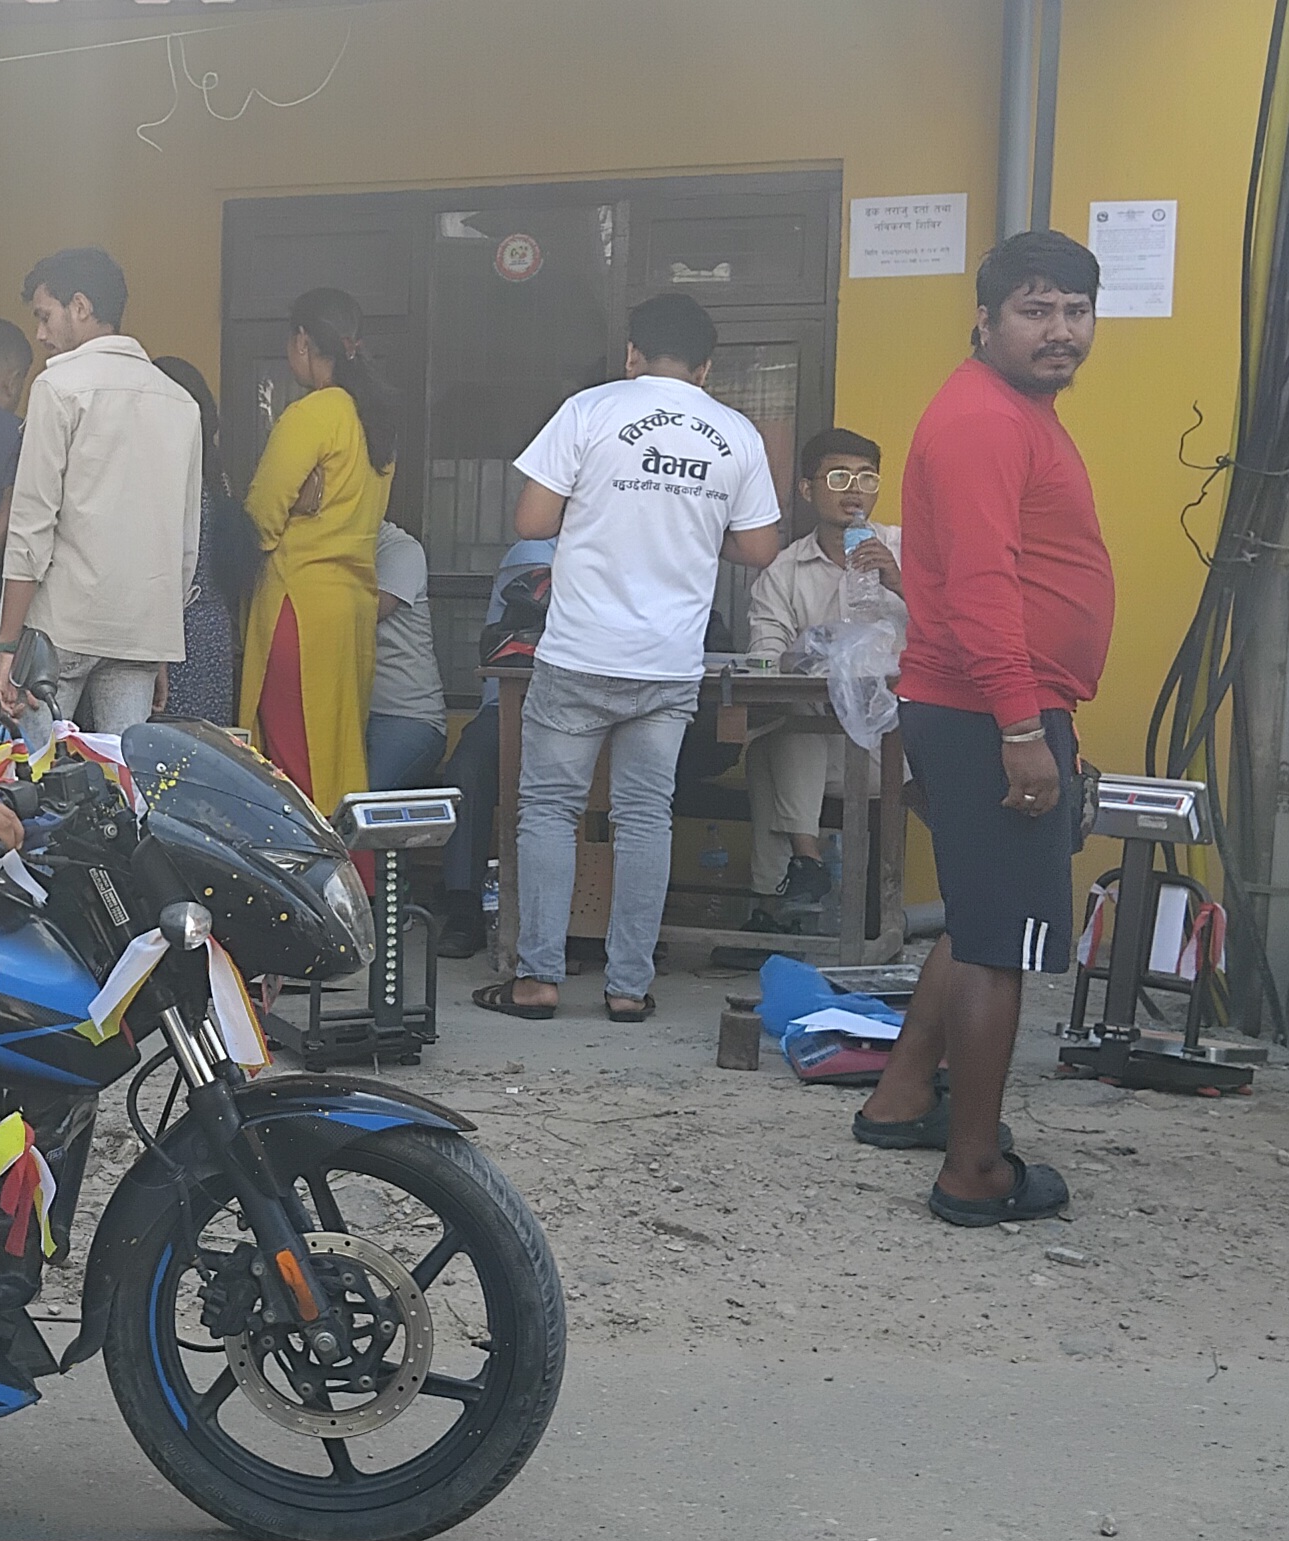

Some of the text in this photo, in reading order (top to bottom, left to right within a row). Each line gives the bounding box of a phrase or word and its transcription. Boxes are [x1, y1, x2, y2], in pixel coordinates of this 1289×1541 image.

[690, 416, 732, 457] जात्रा
[642, 446, 712, 481] वैभव
[664, 483, 703, 496] सहकारी
[705, 488, 729, 501] संस्था
